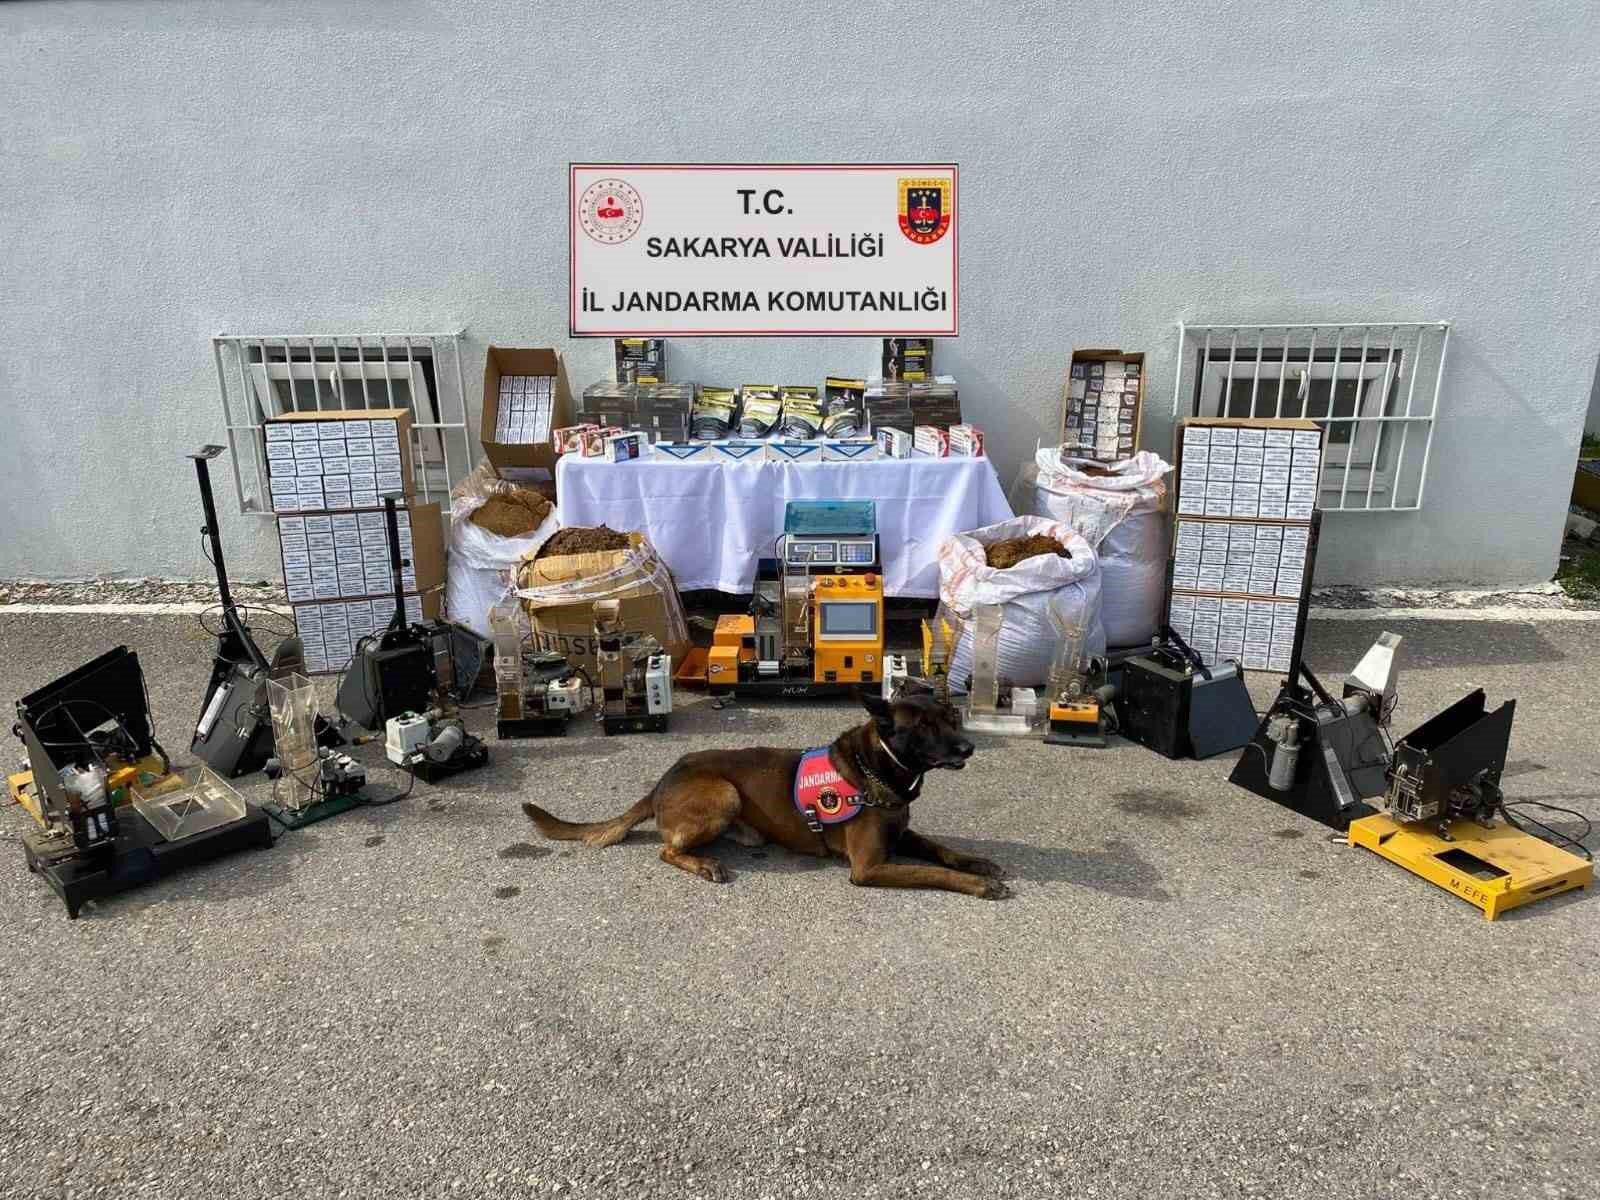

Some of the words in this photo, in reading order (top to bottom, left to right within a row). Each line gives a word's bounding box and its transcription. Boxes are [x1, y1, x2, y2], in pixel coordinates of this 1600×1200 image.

[736, 189, 793, 215] T.C.
[646, 236, 771, 258] SAKARYA
[777, 232, 884, 258] VALİLİĞİ
[582, 287, 605, 312] İL
[611, 291, 761, 312] JANDARMA
[768, 287, 947, 312] KOMUTANLIĞI
